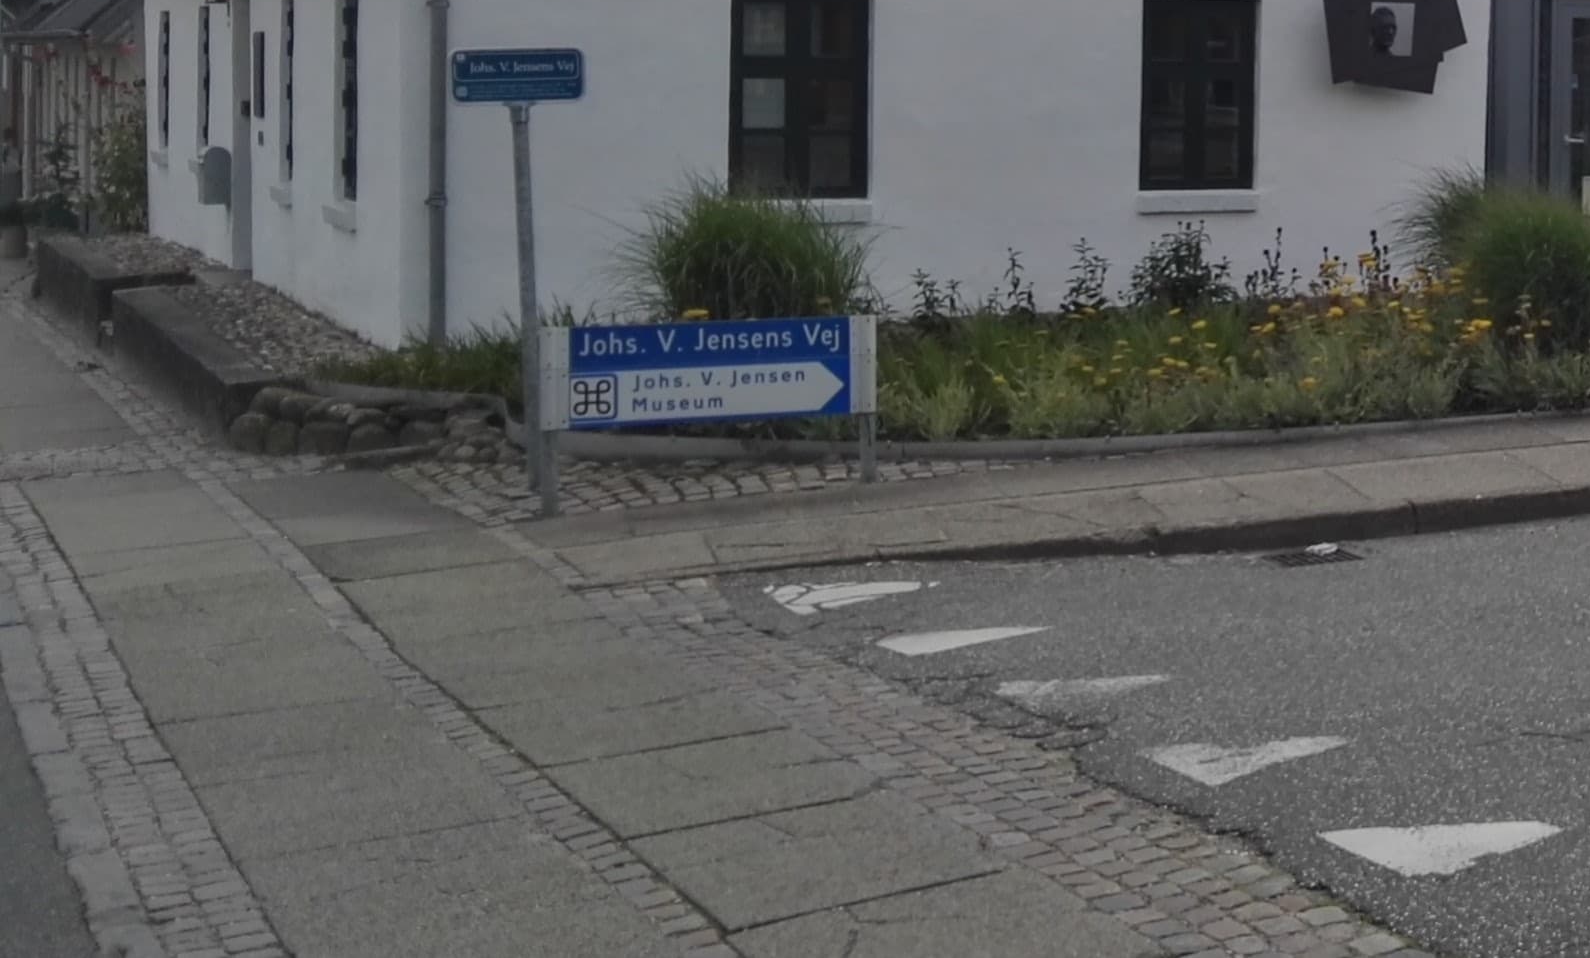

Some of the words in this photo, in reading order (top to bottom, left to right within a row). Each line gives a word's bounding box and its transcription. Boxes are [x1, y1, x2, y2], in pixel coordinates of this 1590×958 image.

[470, 60, 497, 74] Johs.
[499, 60, 511, 73] V.
[556, 60, 575, 74] Vej
[578, 331, 647, 357] Johs.
[656, 329, 684, 353] V.
[694, 328, 793, 352] Jensens
[803, 323, 841, 352] Vej
[632, 374, 691, 392] Johs.
[701, 371, 722, 387] V.
[730, 369, 806, 388] Jensen
[632, 395, 723, 413] Museum
